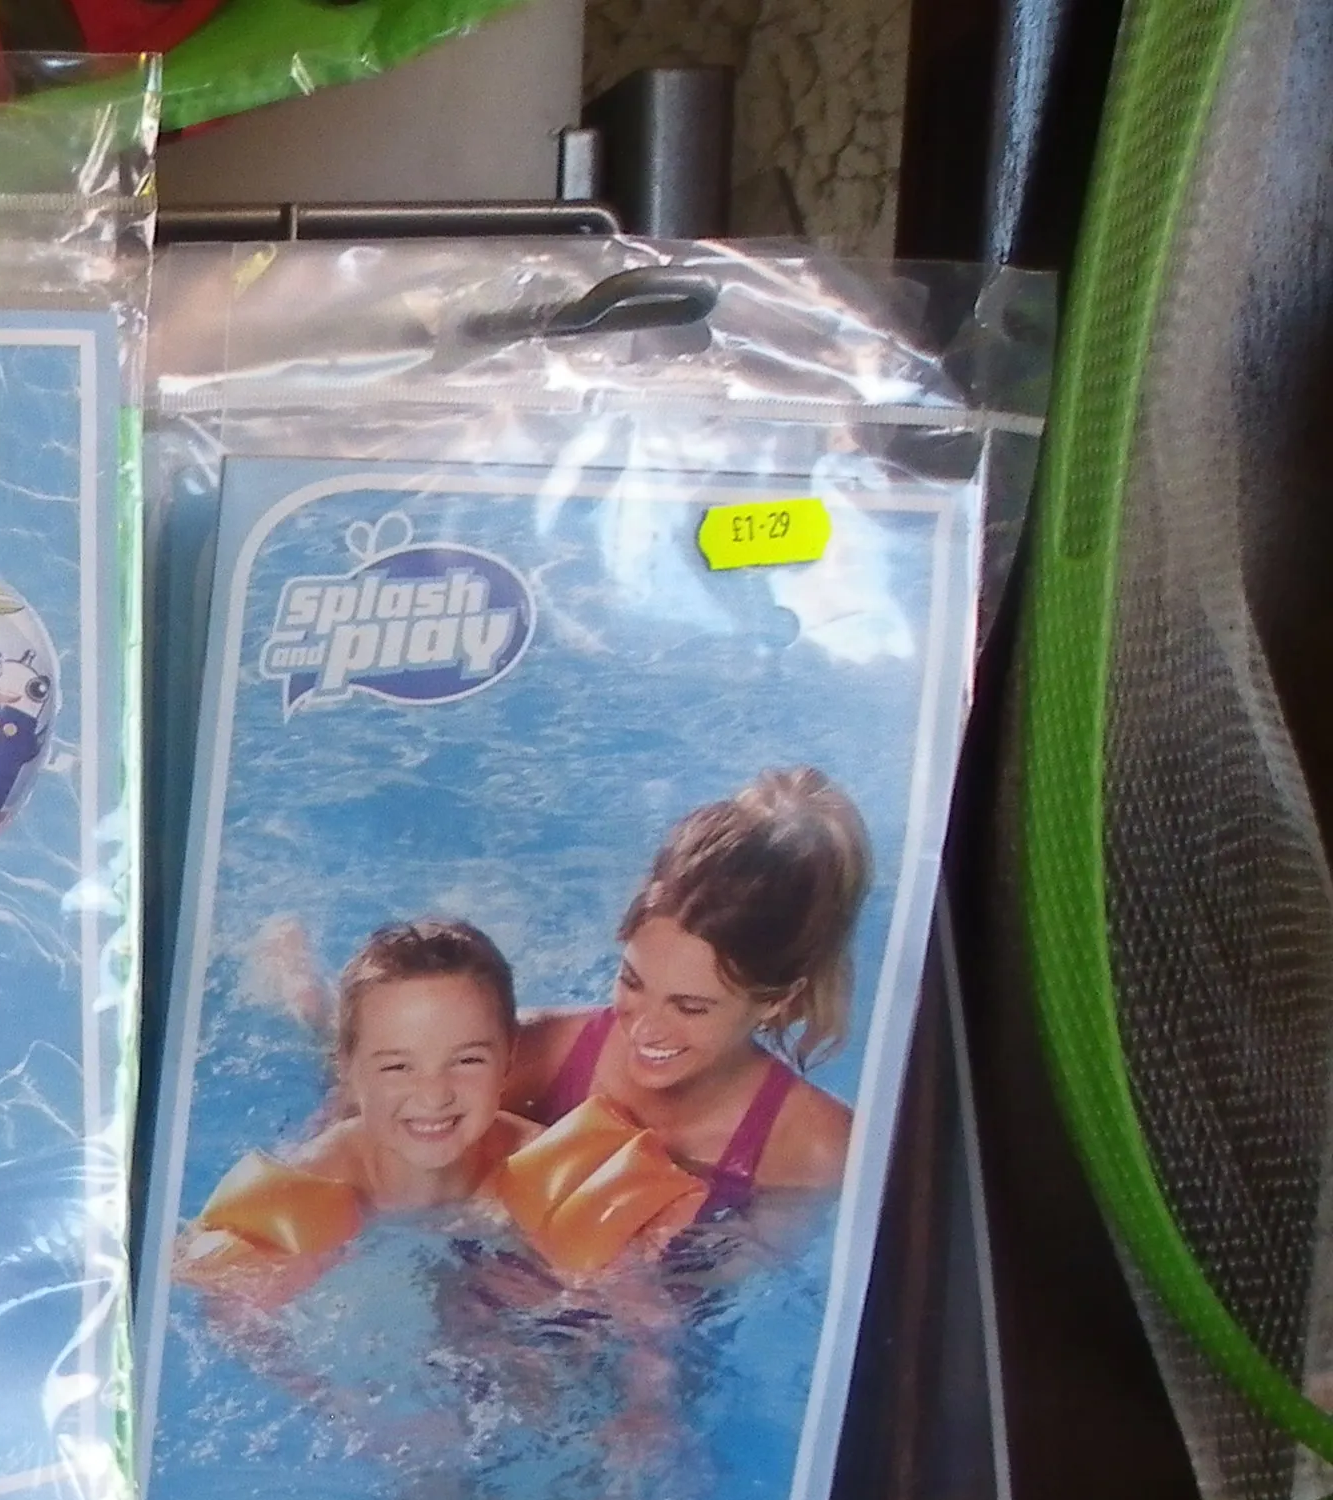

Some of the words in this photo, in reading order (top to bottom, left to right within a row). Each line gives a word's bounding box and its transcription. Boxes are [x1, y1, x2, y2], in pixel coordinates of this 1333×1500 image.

[286, 569, 487, 625] splash
[271, 639, 325, 669] and
[321, 610, 512, 690] play
